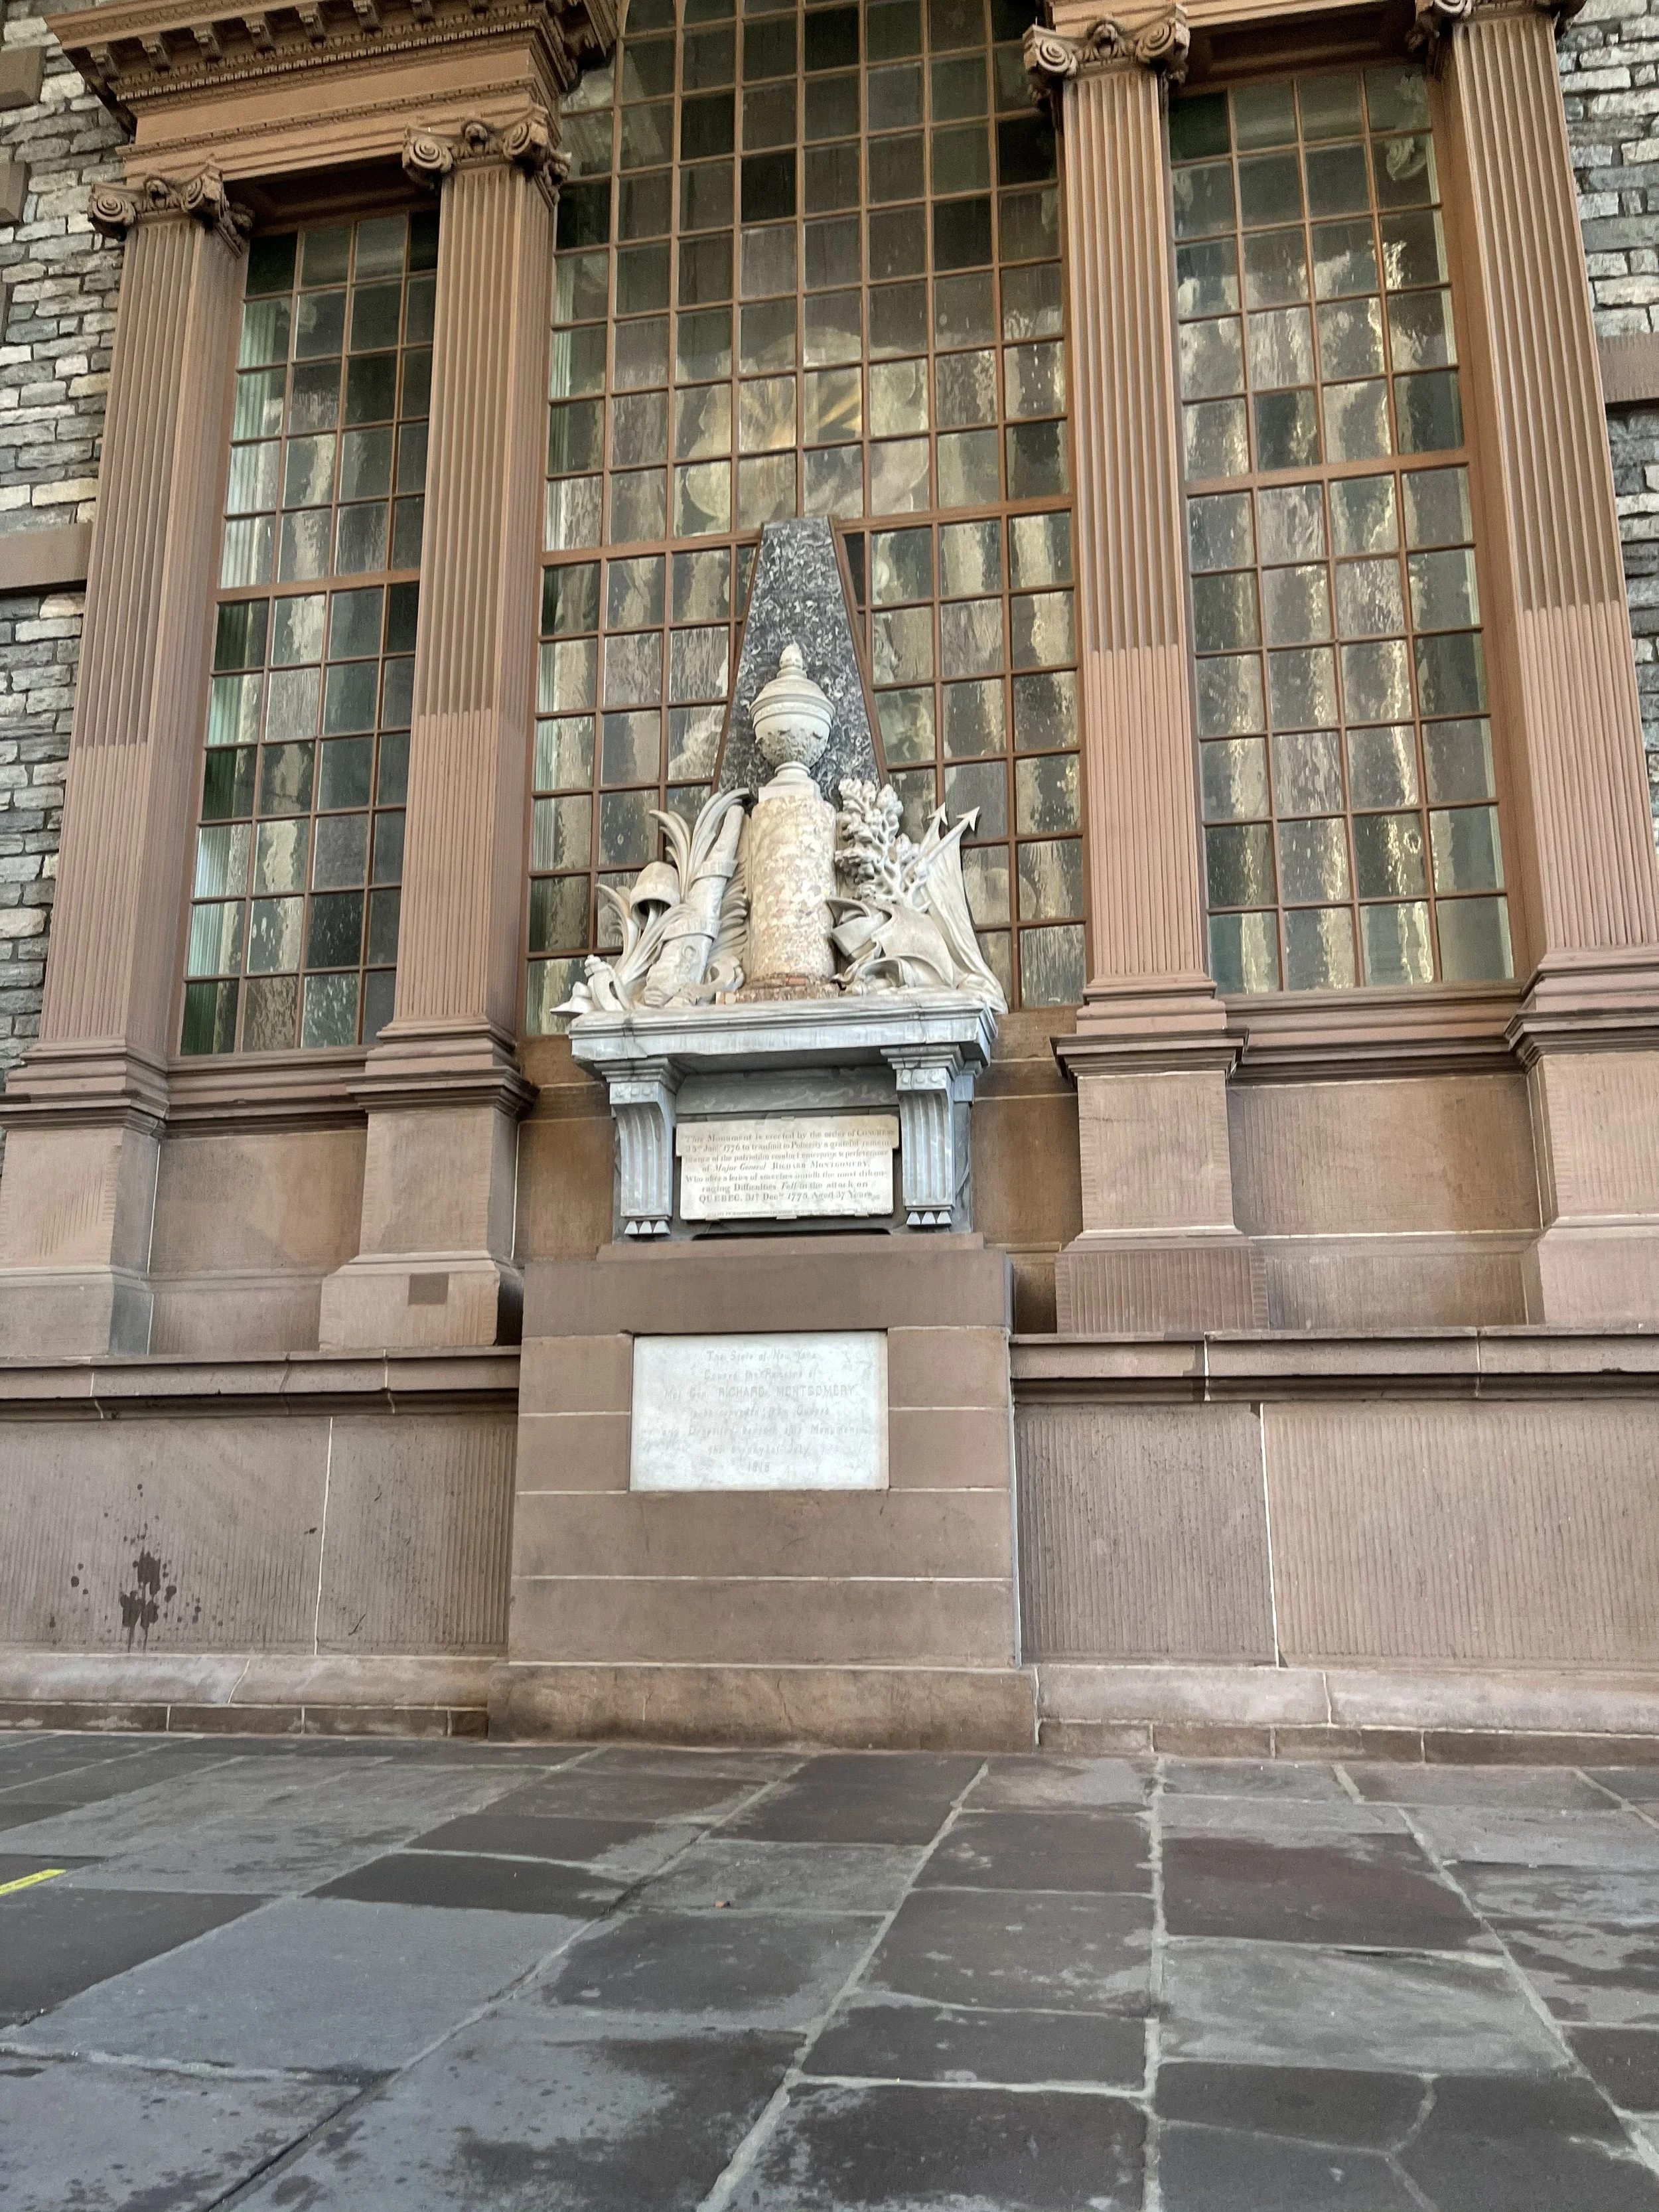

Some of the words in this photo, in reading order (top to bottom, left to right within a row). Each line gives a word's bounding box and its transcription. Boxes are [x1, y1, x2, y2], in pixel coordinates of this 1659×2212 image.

[797, 1131, 807, 1140] by
[723, 1143, 741, 1153] 1776
[715, 1163, 737, 1174] Major
[739, 1161, 766, 1171] General
[734, 1182, 778, 1193] Difficulties
[781, 1181, 798, 1191] Fell
[810, 1181, 824, 1189] the
[827, 1179, 854, 1189] attack
[836, 1190, 846, 1201] 37
[718, 1385, 766, 1398] RICHARD
[776, 1383, 857, 1398] MONTGOMERY
